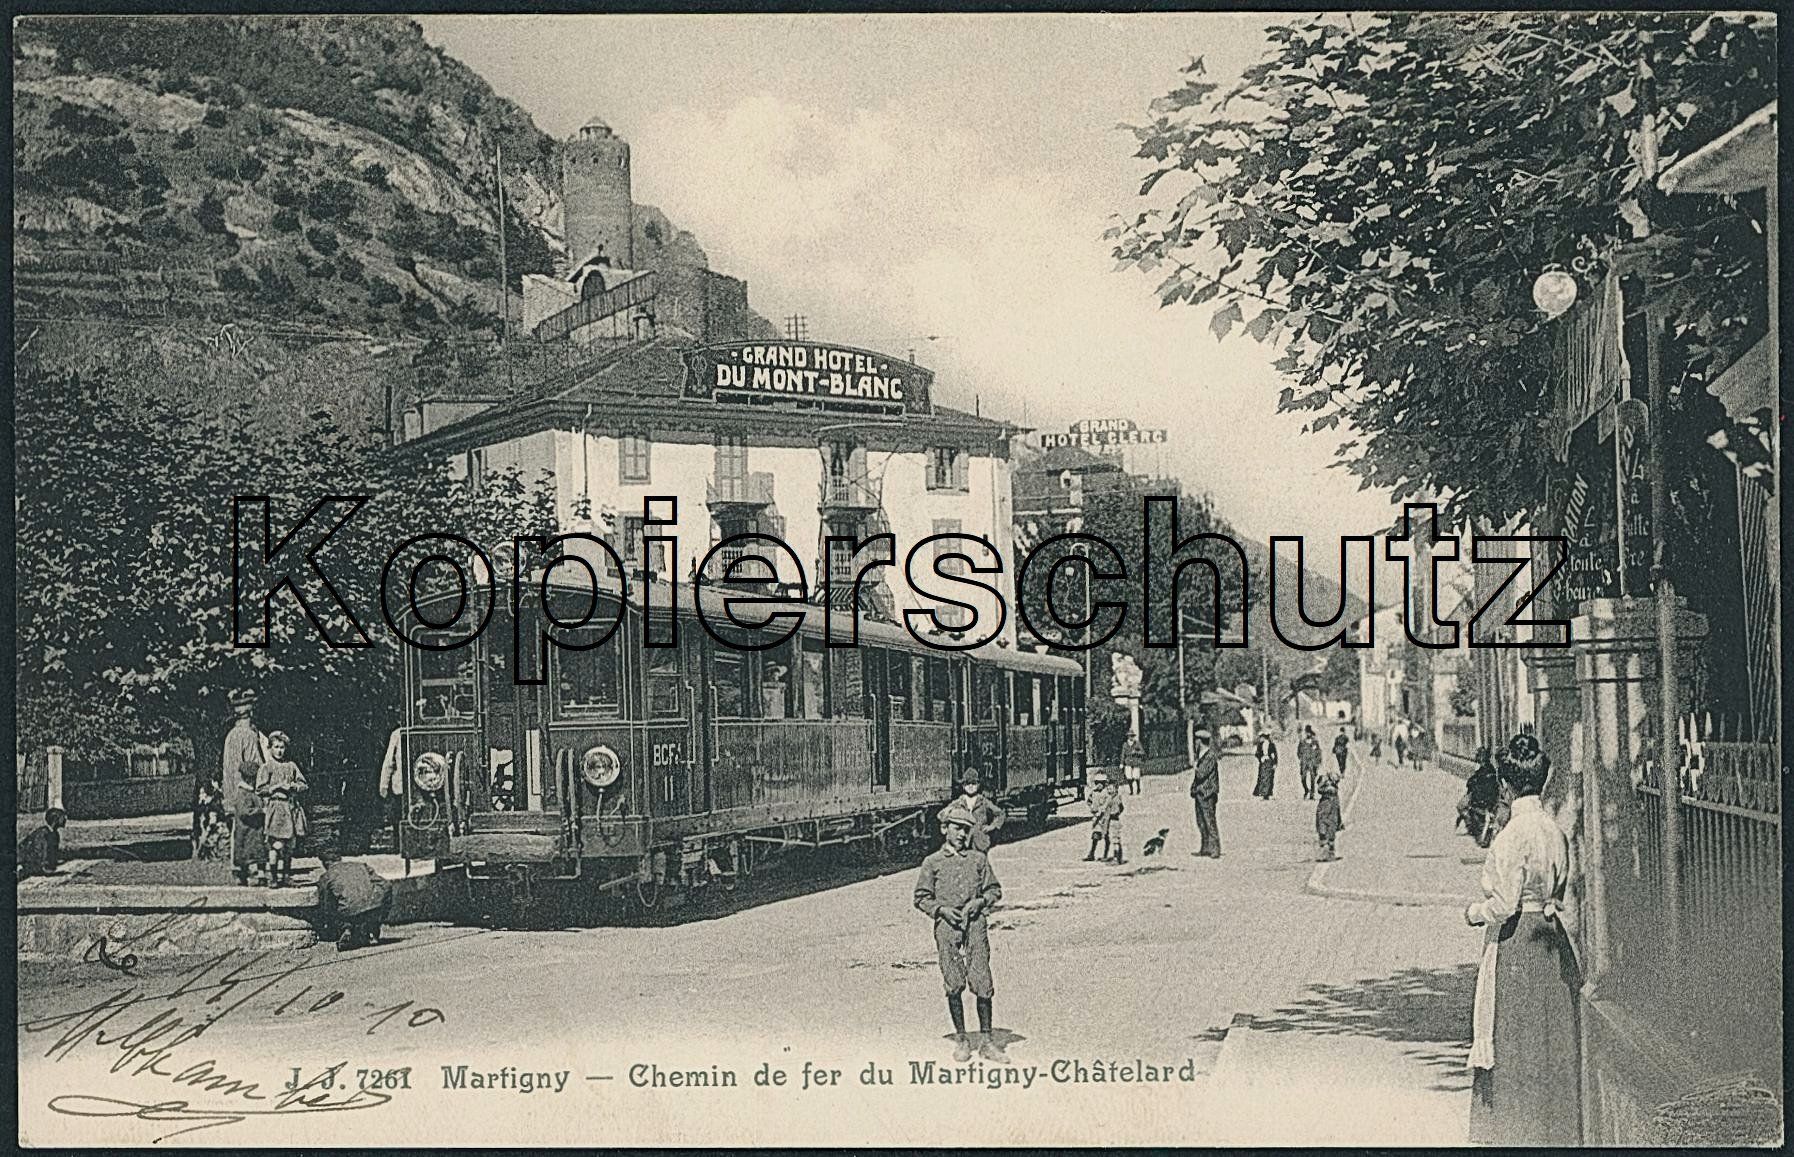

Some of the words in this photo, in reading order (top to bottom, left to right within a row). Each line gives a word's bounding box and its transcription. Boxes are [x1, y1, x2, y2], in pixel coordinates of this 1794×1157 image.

[742, 346, 807, 368] GRAND
[814, 348, 877, 374] HOTEL
[716, 364, 745, 387] DU
[752, 366, 903, 399] MONT-BLANC
[1080, 419, 1128, 433] GRAND
[1045, 432, 1101, 447] HOTEL
[1107, 429, 1163, 444] CLERC
